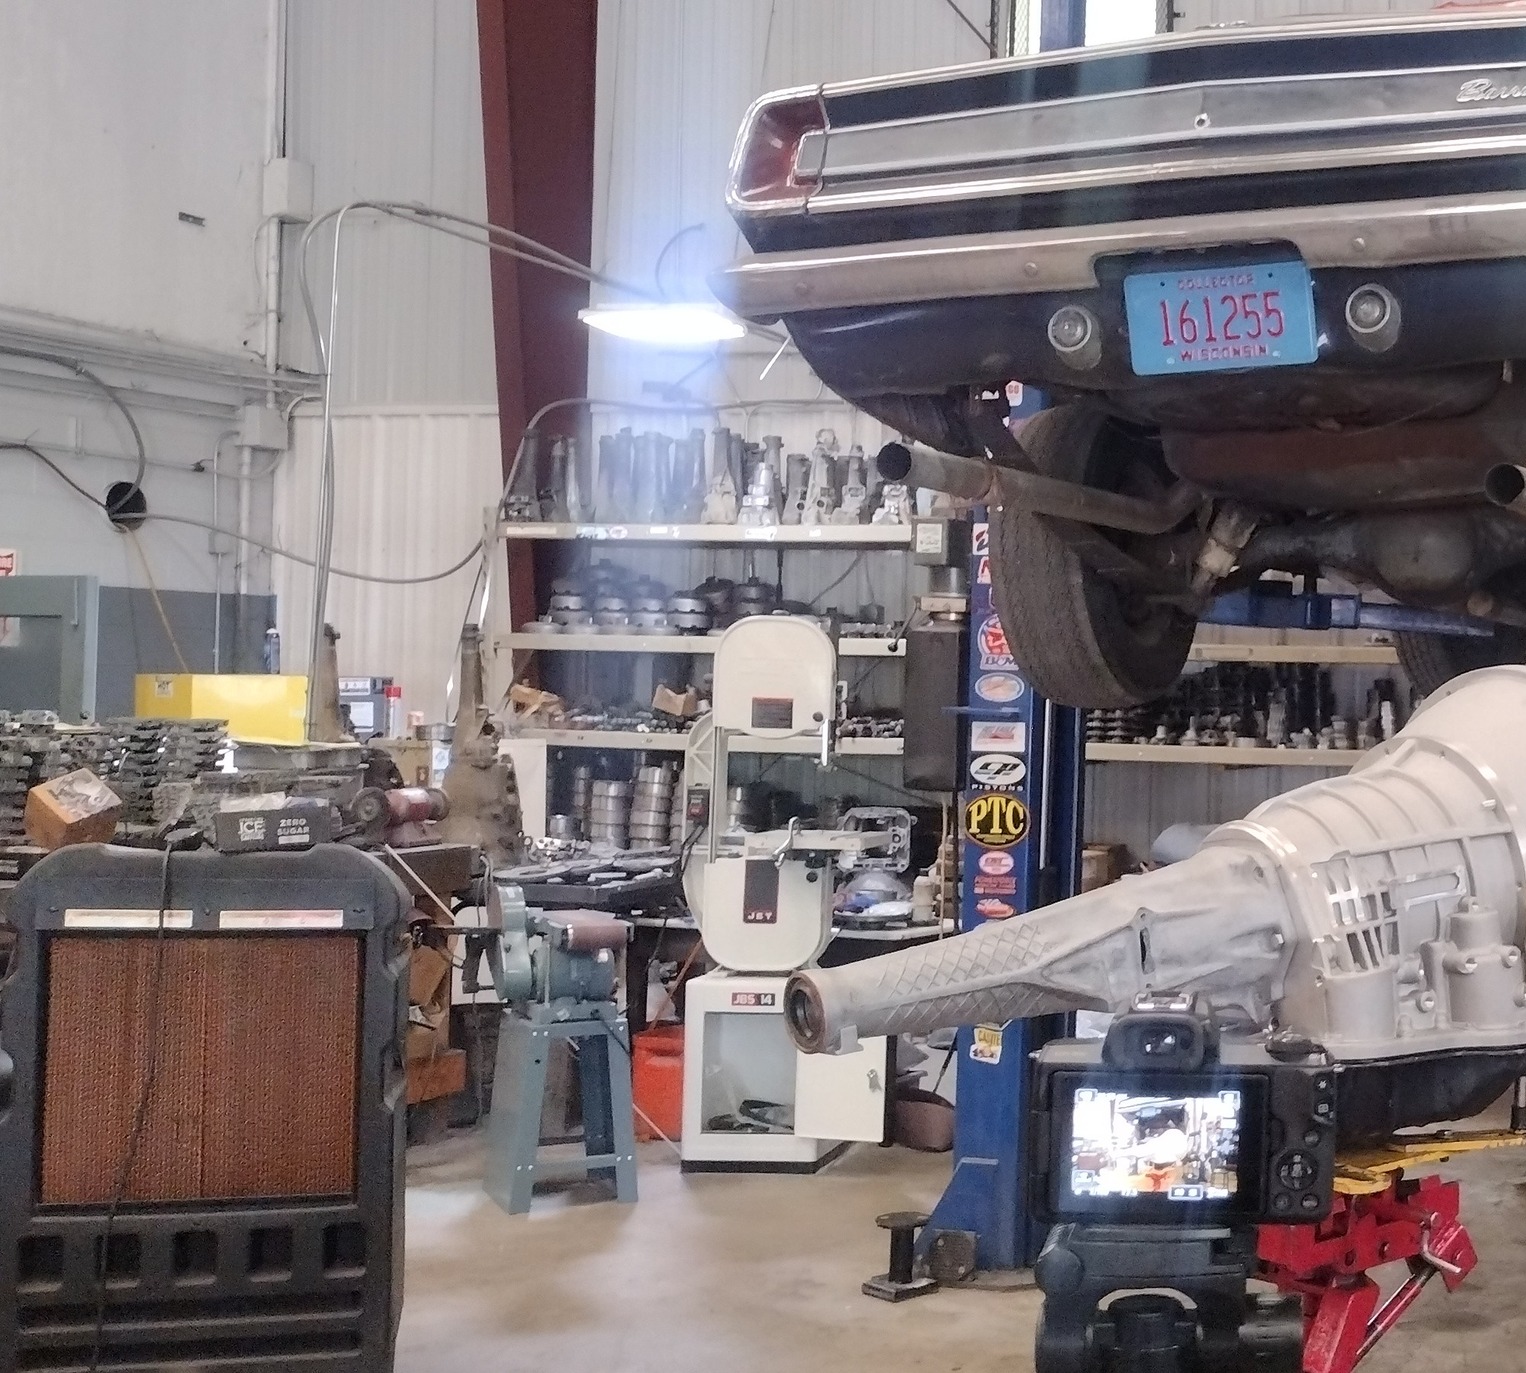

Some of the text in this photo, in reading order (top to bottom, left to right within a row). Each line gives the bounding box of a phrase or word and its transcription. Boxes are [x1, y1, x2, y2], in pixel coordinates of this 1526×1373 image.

[1178, 273, 1255, 291] COLLECTOR
[1160, 289, 1286, 347] 161255
[1180, 344, 1269, 362] WISCONSIN
[280, 818, 307, 828] ZERO
[968, 796, 1025, 836] PTC
[277, 826, 310, 836] SUGAR
[760, 994, 772, 1005] 14
